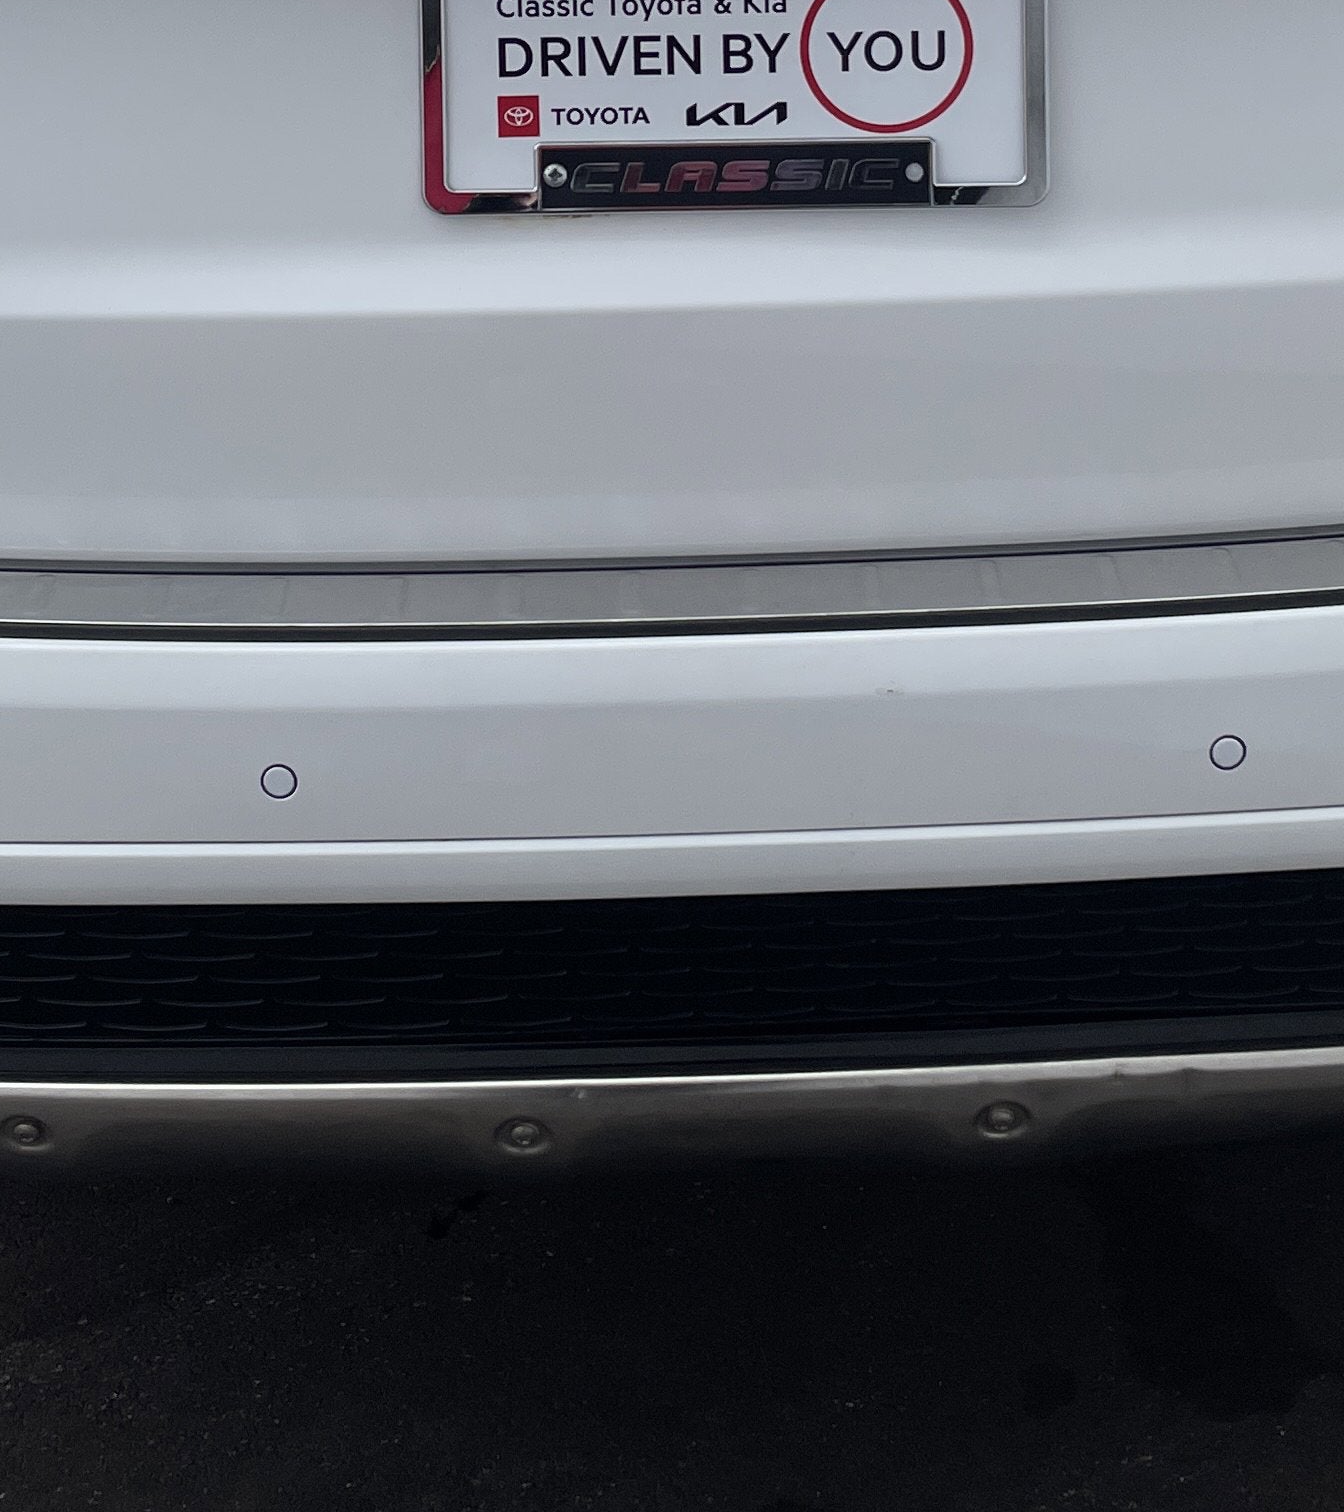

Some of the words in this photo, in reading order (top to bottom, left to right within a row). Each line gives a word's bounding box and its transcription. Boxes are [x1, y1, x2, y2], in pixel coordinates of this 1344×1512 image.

[498, 34, 702, 78] DRIVEN
[723, 33, 791, 74] BY
[827, 31, 946, 72] YOU
[551, 107, 650, 126] TOYOTA
[686, 101, 788, 127] KIA
[570, 159, 900, 194] CLASSIC
